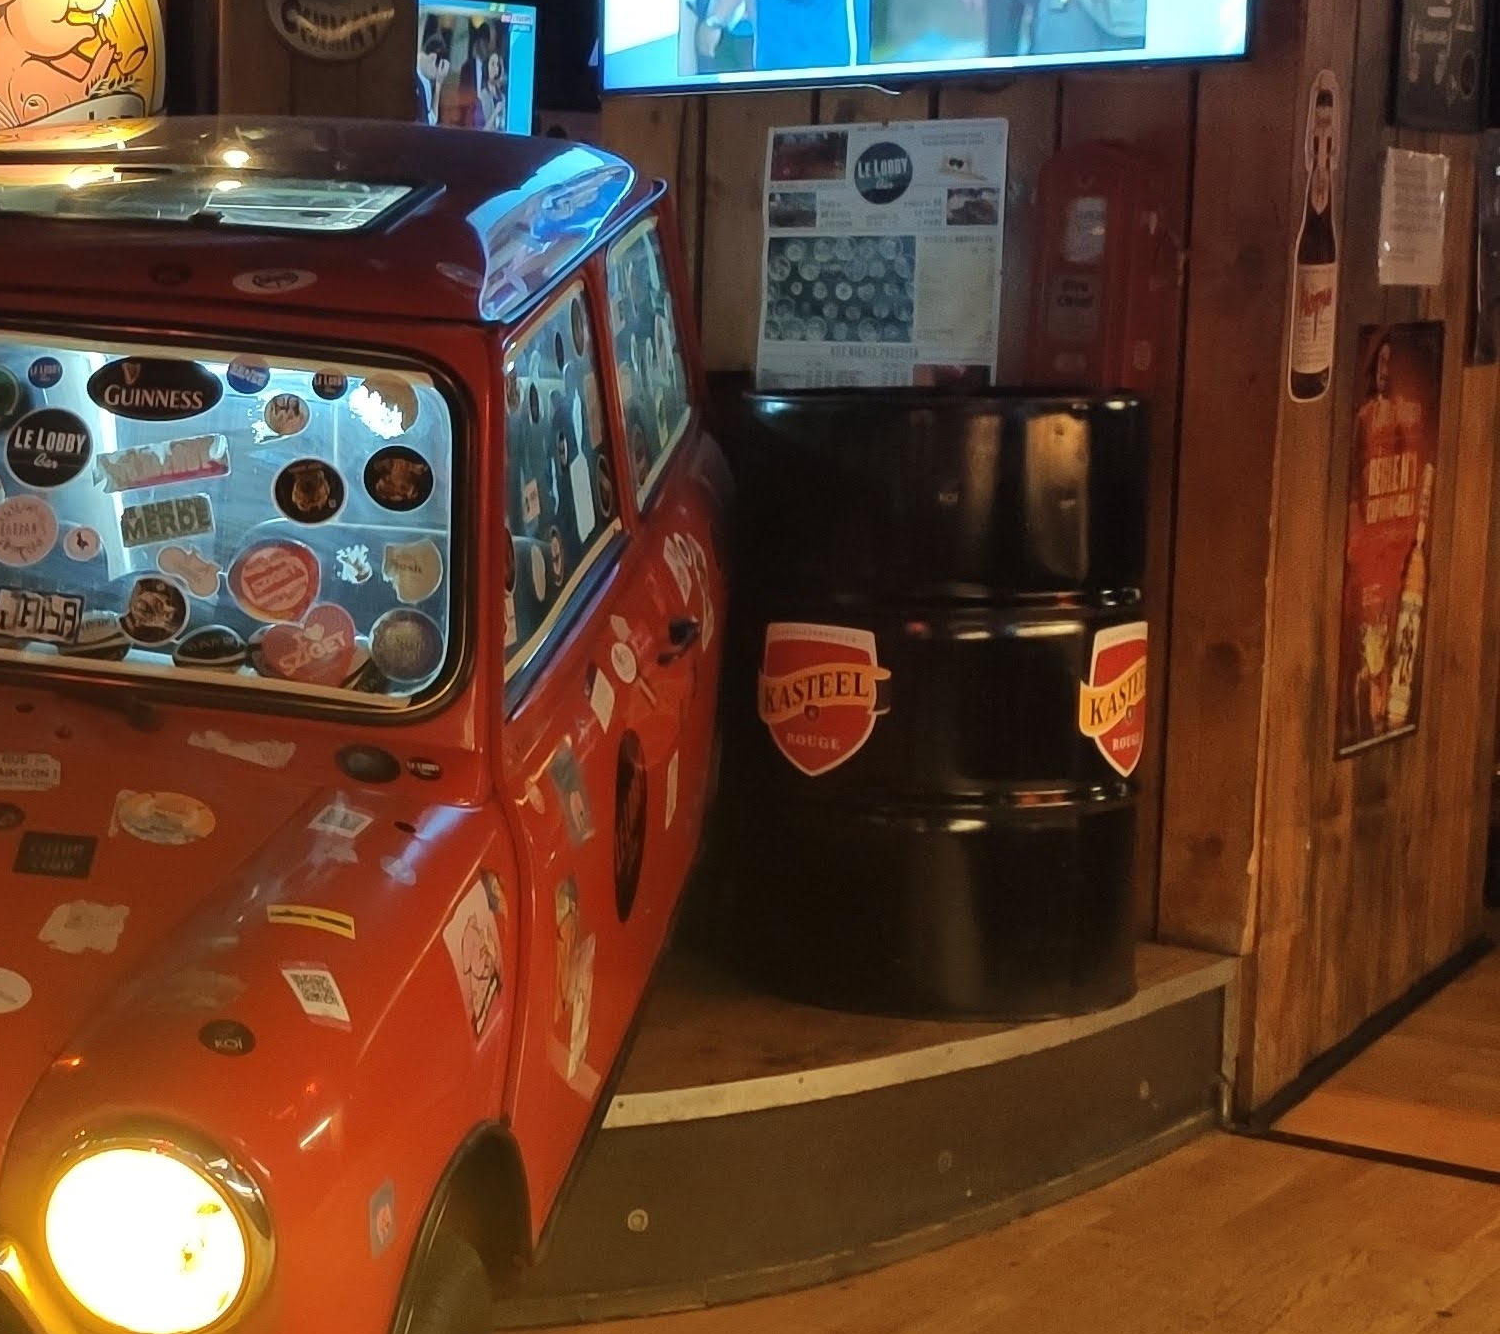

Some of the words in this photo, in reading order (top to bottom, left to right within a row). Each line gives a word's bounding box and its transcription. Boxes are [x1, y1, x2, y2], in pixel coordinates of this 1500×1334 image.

[104, 383, 204, 410] GUINNESS
[14, 426, 34, 449] LE
[36, 427, 86, 455] LOBBY
[33, 452, 59, 469] Bar
[279, 629, 346, 677] SZIGET
[765, 671, 870, 714] KASTEEL
[787, 732, 841, 750] ROUGE
